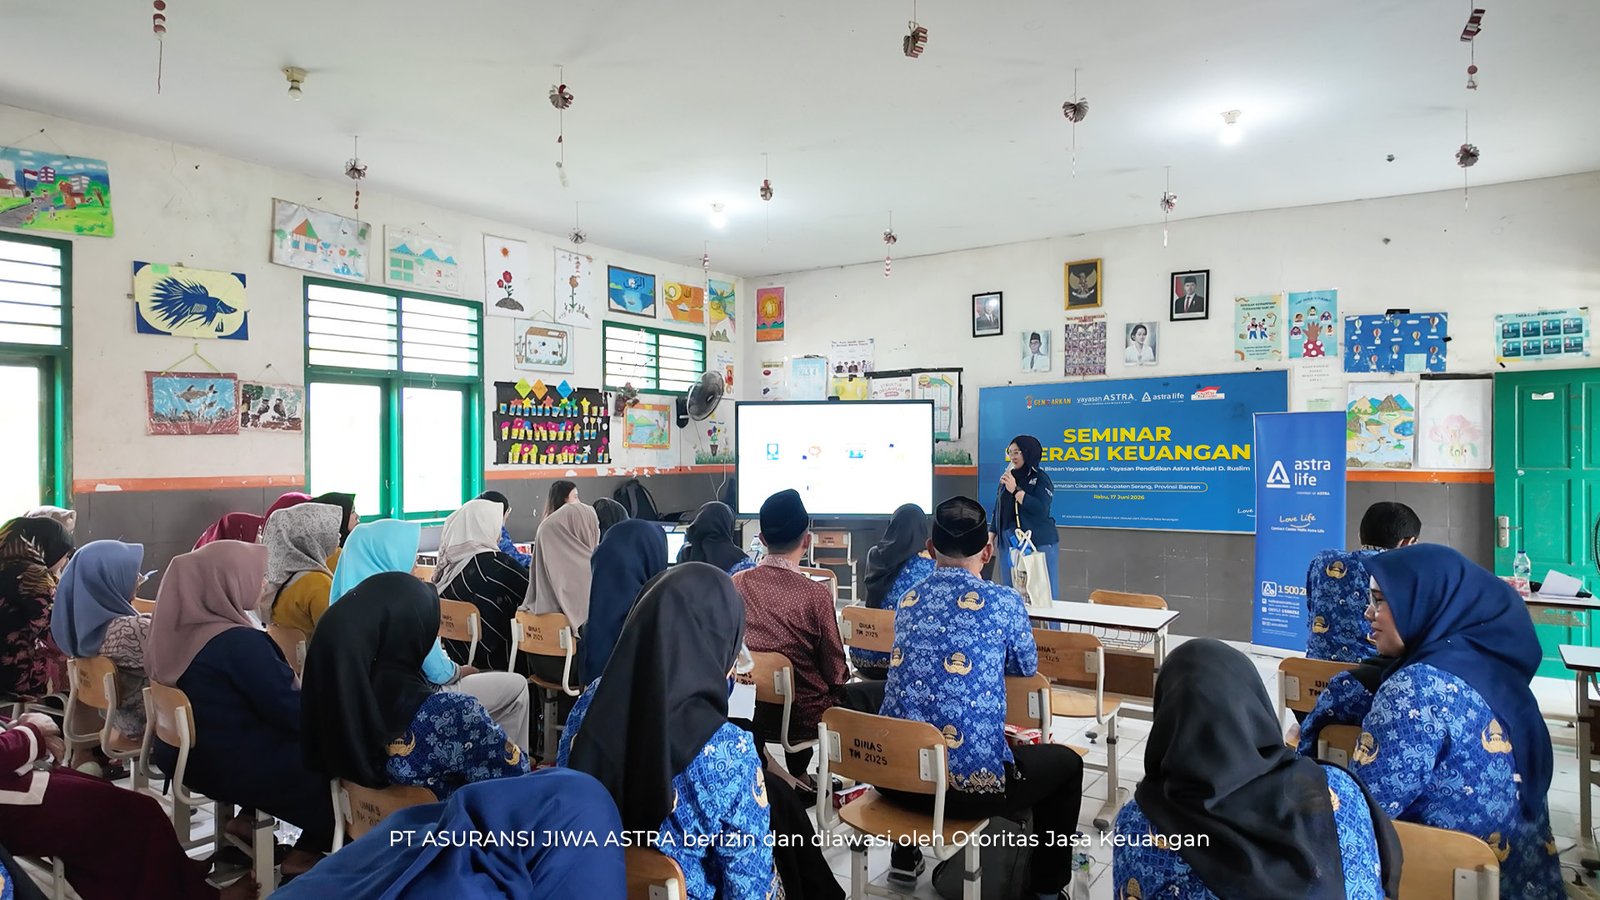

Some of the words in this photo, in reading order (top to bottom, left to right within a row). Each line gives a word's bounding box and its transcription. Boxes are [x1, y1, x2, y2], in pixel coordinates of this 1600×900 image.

[1103, 393, 1134, 401] ASTRA
[1063, 426, 1172, 443] SEMINAR
[1041, 446, 1100, 461] ERASI
[1107, 444, 1251, 461] KEUANGAN
[1294, 458, 1331, 471] astra
[1294, 472, 1317, 486] life
[1300, 513, 1316, 523] Life
[858, 622, 876, 631] DINAS
[865, 630, 879, 638] 2025
[854, 738, 883, 753] DINAS
[864, 752, 888, 766] 2025
